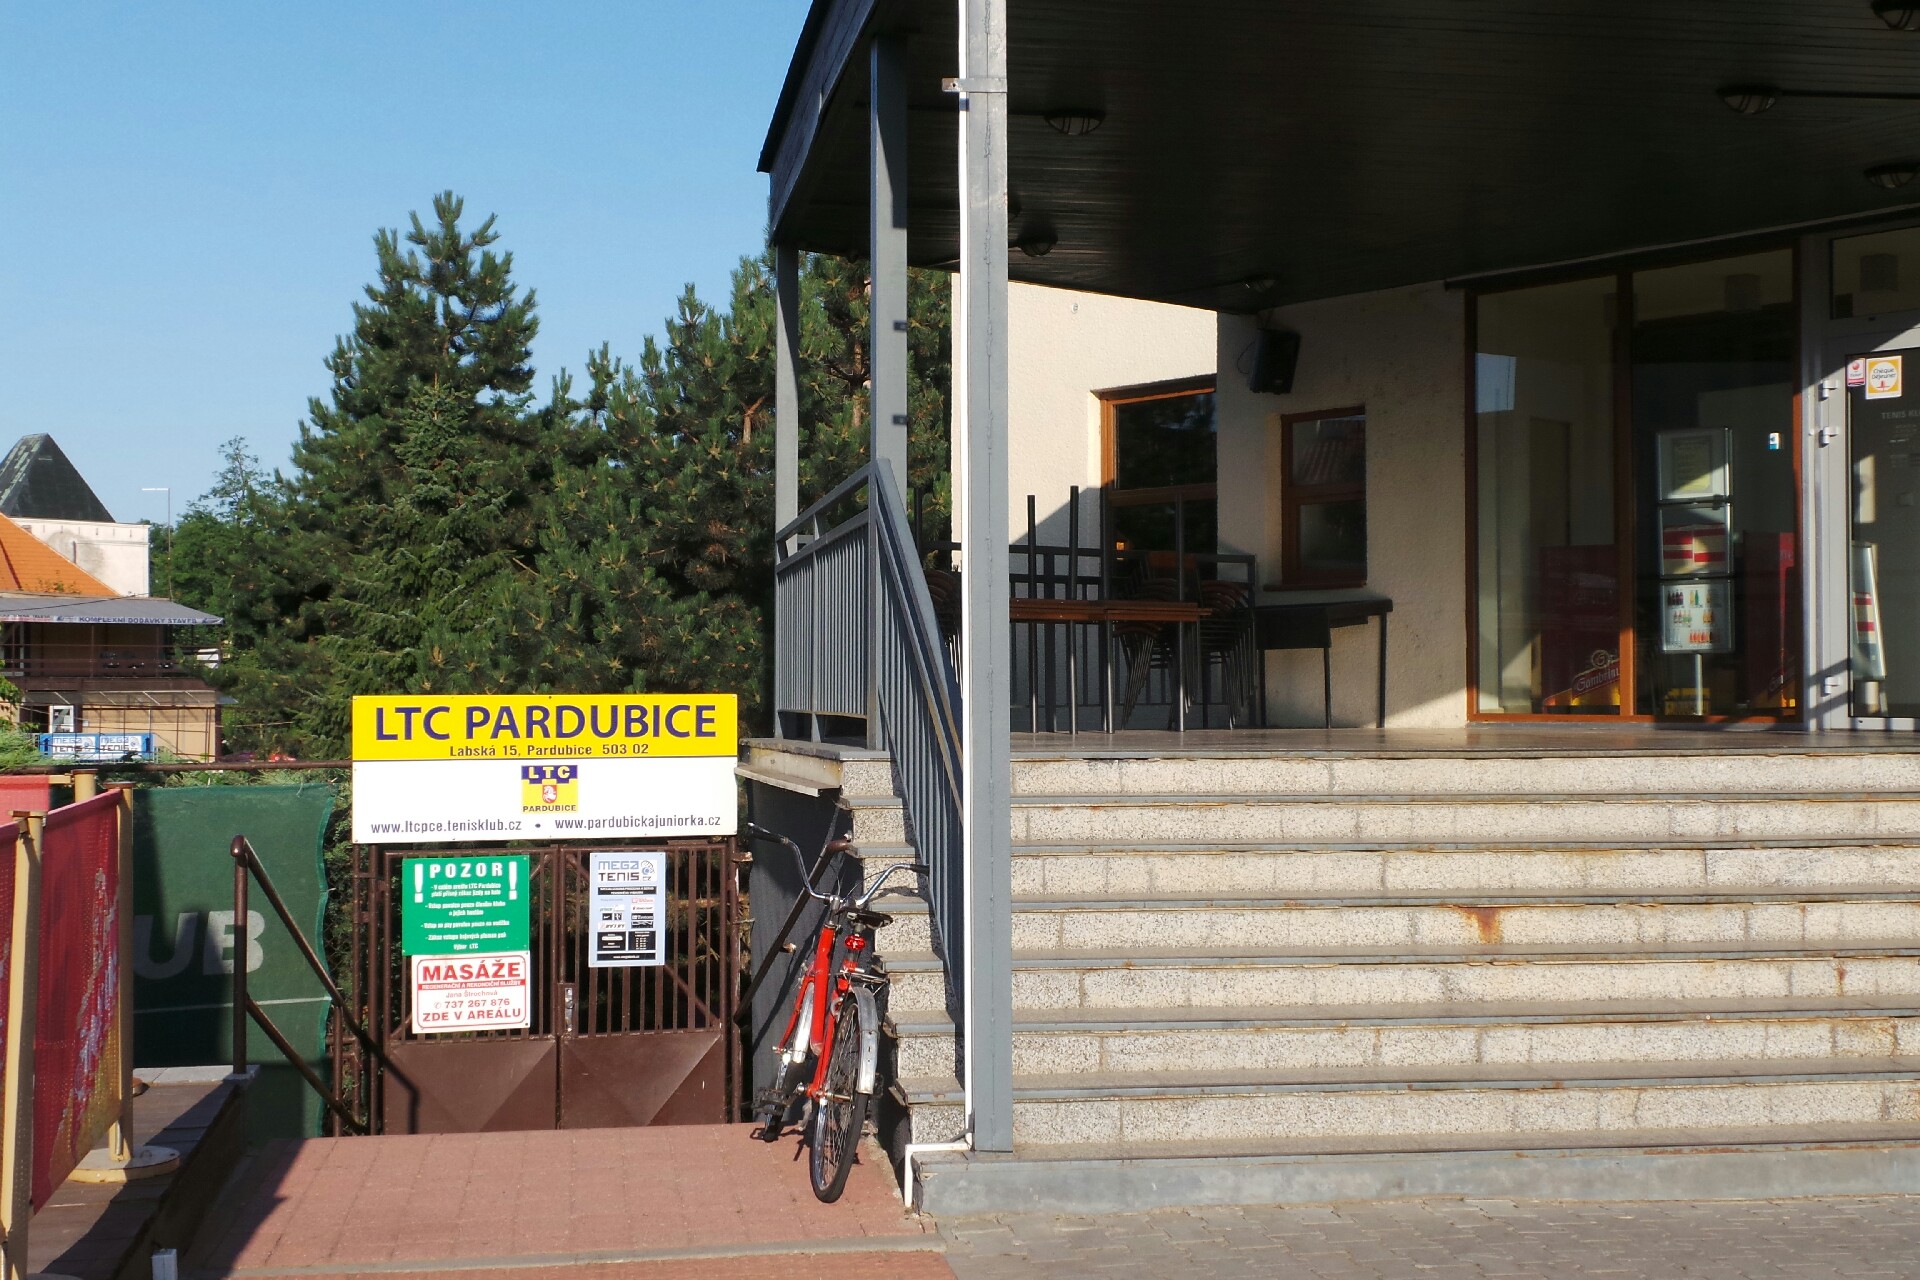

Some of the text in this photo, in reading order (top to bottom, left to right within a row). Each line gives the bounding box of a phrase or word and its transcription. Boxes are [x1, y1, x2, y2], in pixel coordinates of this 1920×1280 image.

[1880, 409, 1920, 419] TENIS KL
[376, 704, 716, 741] LTC PARDUBICE
[450, 744, 649, 758] Labská 15, Pardubice 503 02
[528, 766, 570, 779] LTC
[522, 805, 577, 813] PARDUBICE
[370, 818, 522, 834] www.ltcpce.tenisklub.cz
[554, 814, 721, 830] www.pardubickajuniorka.cz
[429, 862, 503, 878] POZOR
[598, 872, 639, 881] TENIS
[422, 960, 521, 981] MASÁŽE
[491, 998, 510, 1006] 876
[423, 1007, 521, 1022] ZDE V AREÁLU
